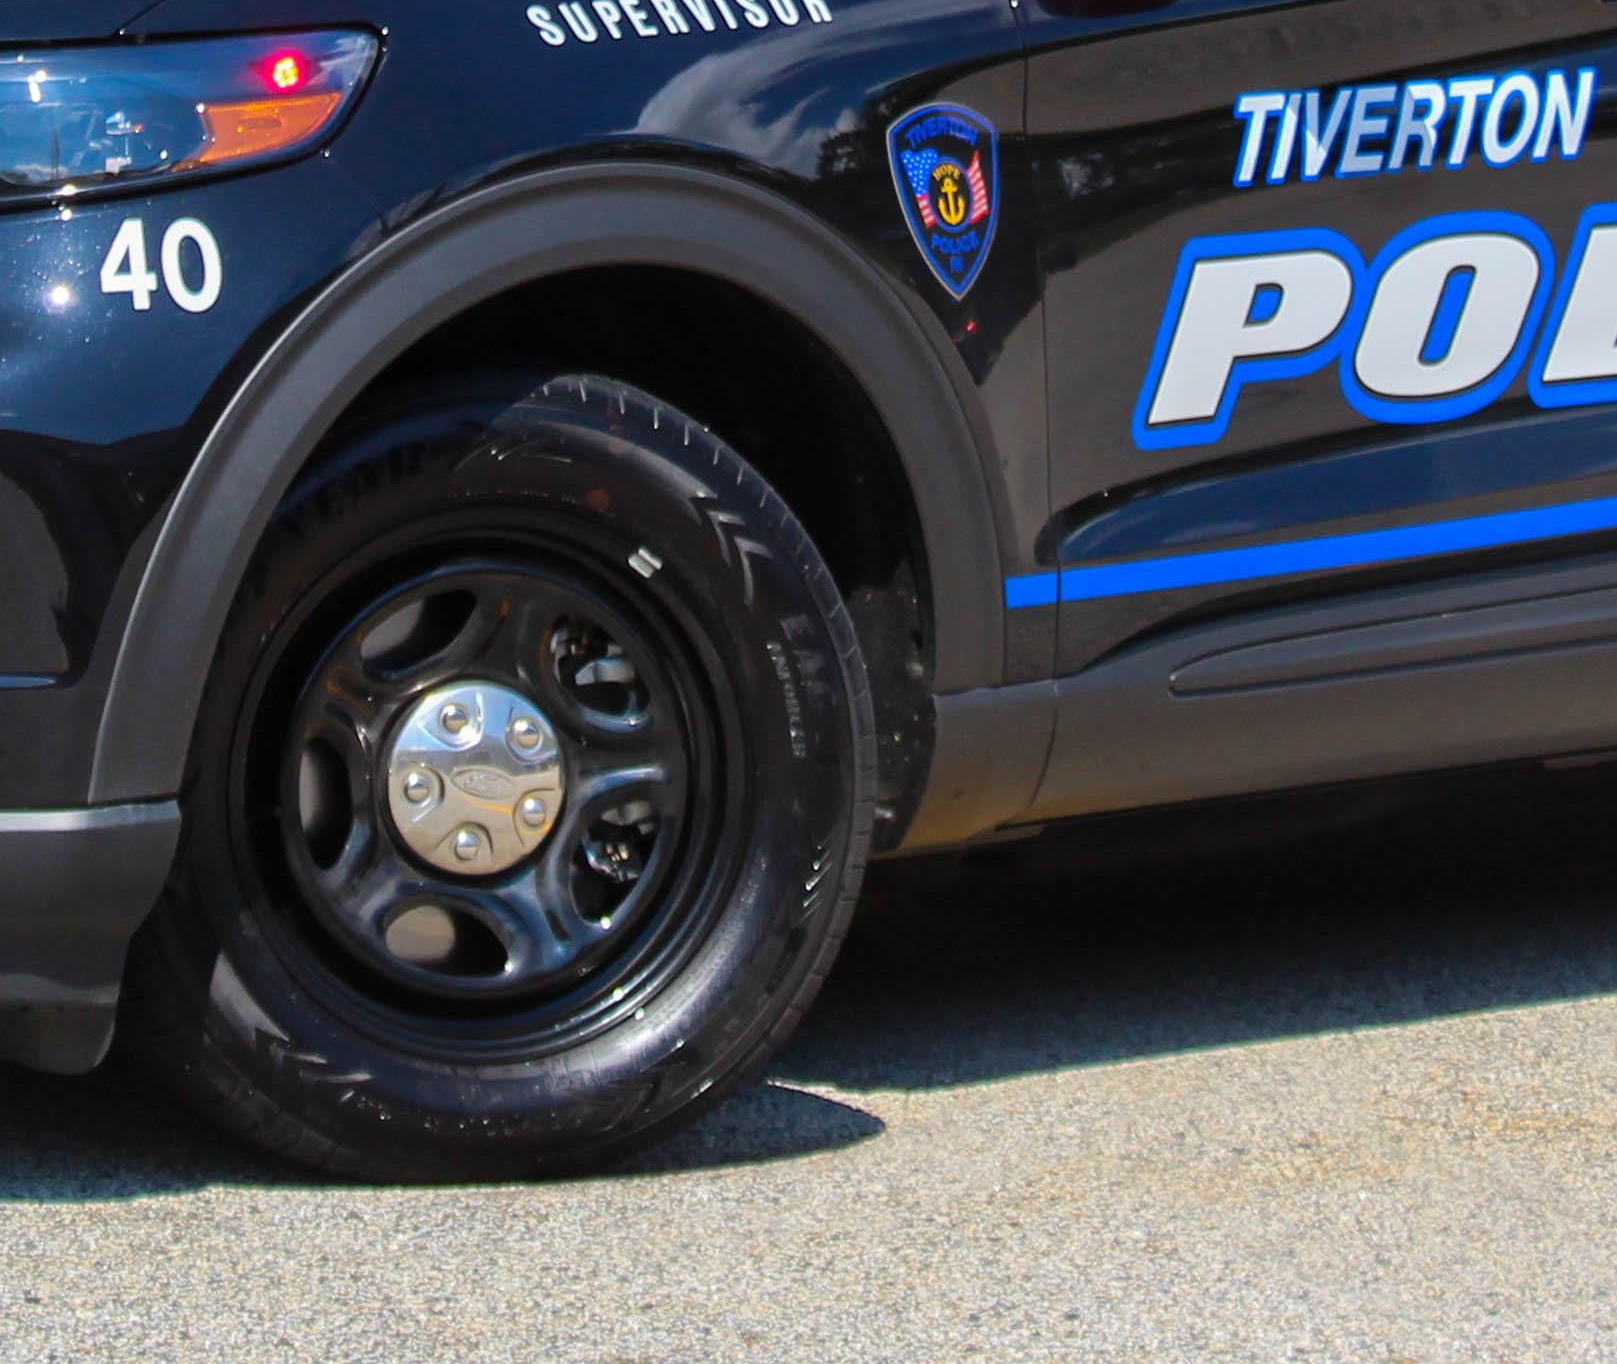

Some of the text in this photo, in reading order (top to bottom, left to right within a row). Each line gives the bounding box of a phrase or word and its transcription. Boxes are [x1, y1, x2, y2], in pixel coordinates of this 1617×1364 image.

[932, 162, 962, 181] HOPE
[1233, 68, 1597, 186] TIVERTON
[100, 216, 223, 314] 40
